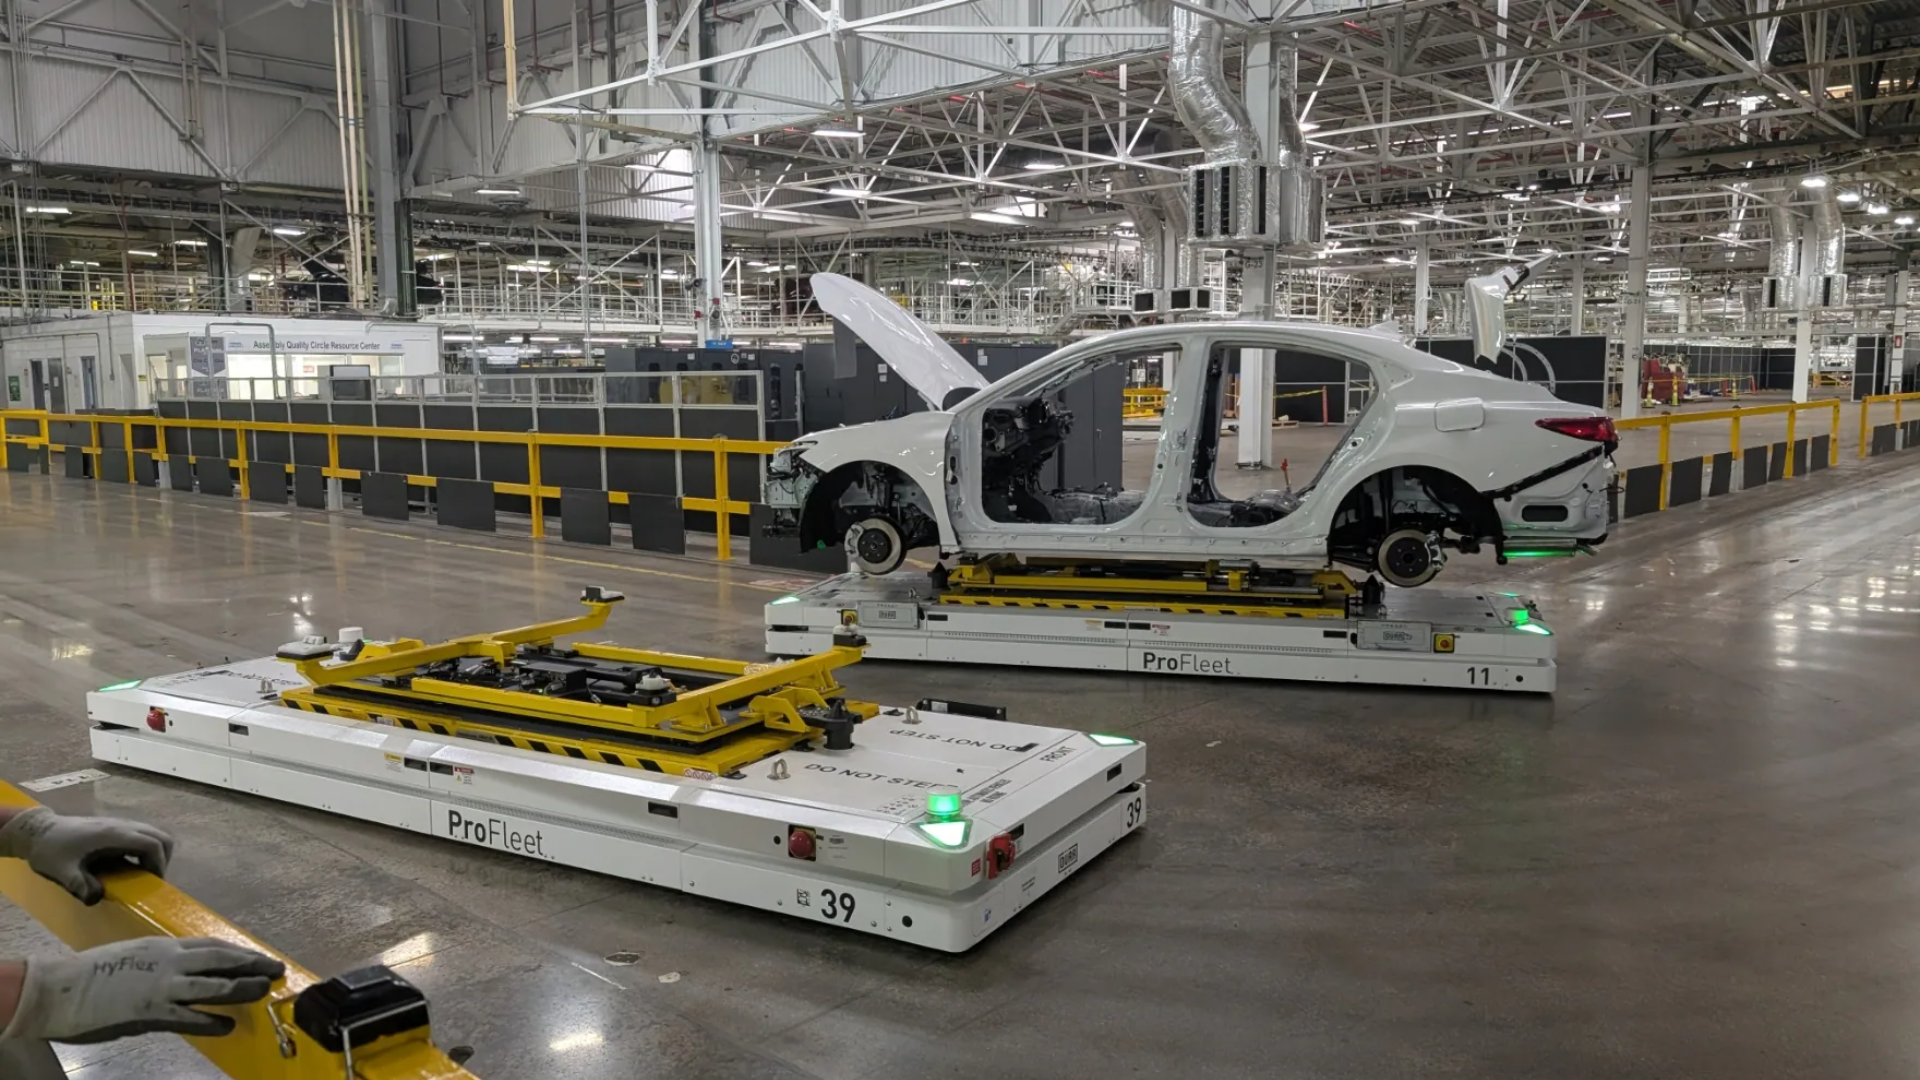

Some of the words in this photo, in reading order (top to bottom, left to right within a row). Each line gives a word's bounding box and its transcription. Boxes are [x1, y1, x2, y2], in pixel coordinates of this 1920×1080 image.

[253, 341, 285, 350] Assebly
[287, 341, 309, 350] Quality
[310, 341, 330, 349] Circle
[360, 342, 380, 350] Center
[1143, 651, 1231, 674] ProFleet
[1467, 666, 1489, 686] 11
[889, 729, 940, 740] STEP
[941, 737, 986, 747] NOT
[804, 763, 837, 773] DO
[839, 769, 887, 781] NOT
[1127, 797, 1142, 828] 39
[448, 809, 544, 857] ProFleet
[820, 888, 856, 923] 39
[93, 956, 159, 977] HyFlex
